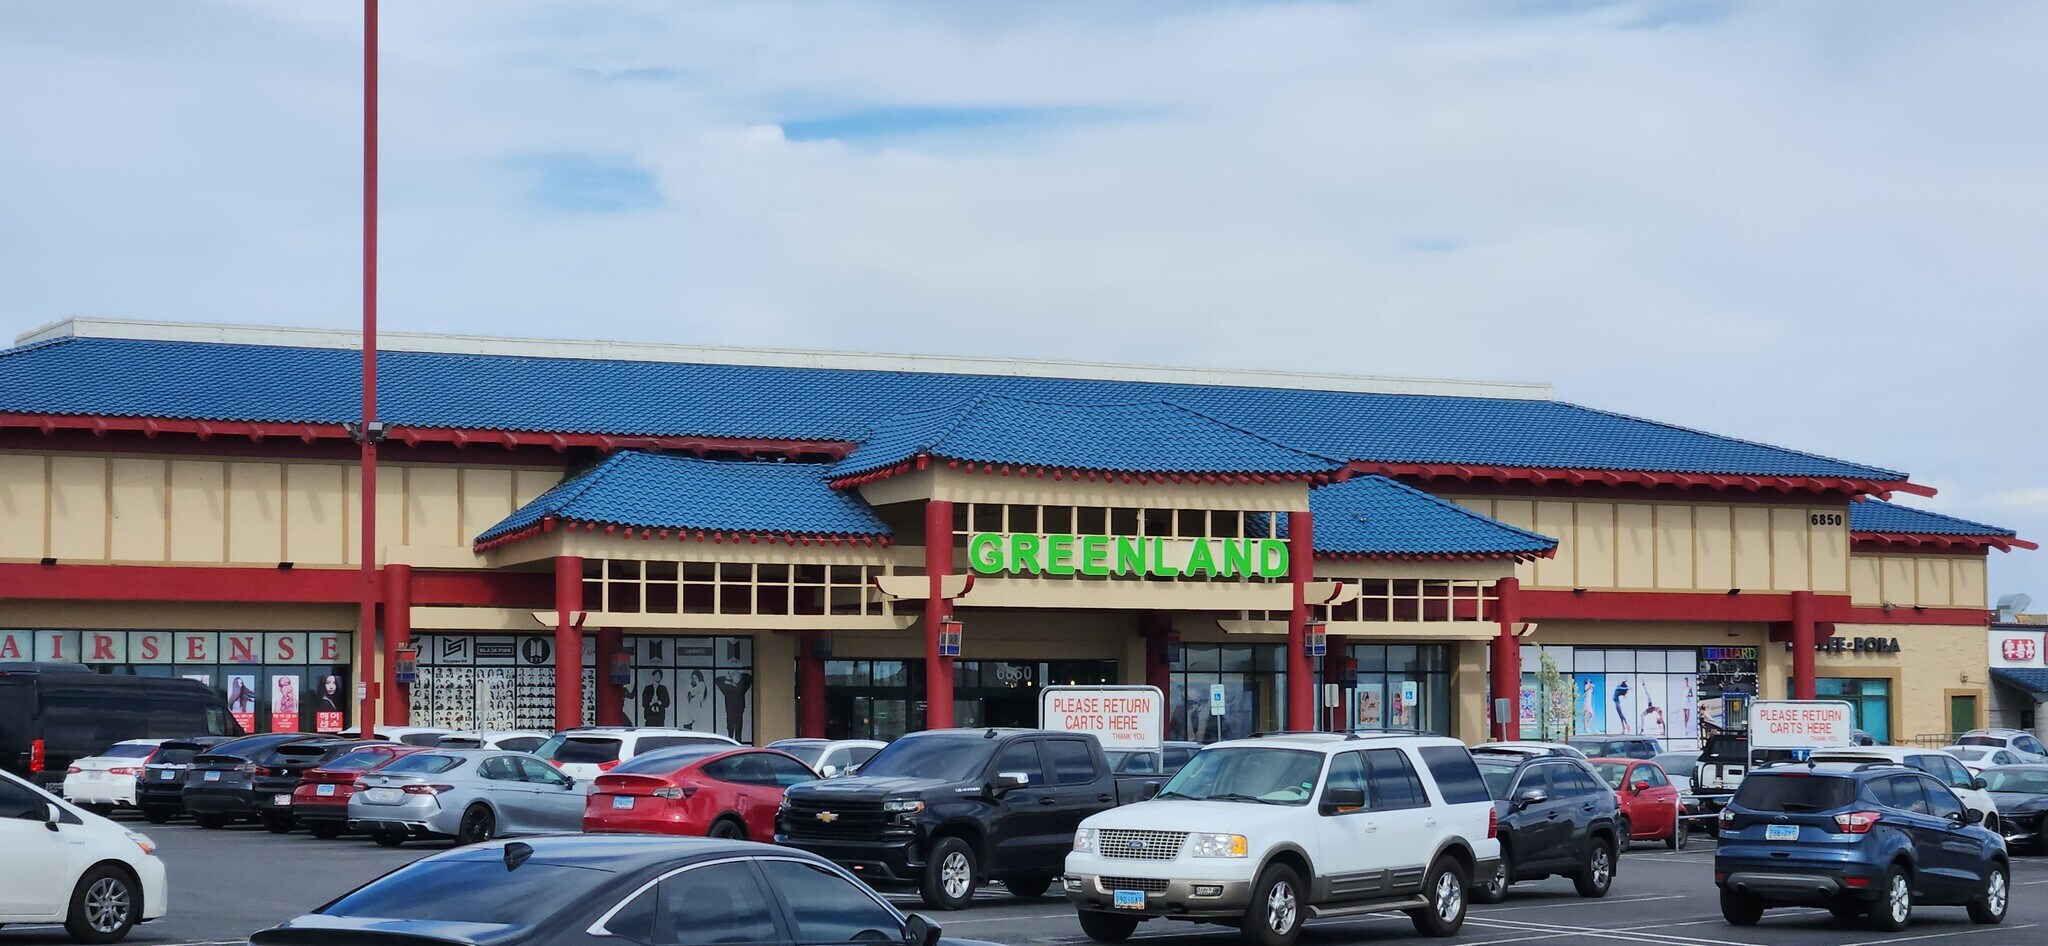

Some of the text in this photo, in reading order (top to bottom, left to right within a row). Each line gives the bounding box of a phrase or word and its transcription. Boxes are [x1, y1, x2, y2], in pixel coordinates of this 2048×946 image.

[1811, 514, 1842, 526] 6850
[968, 532, 1290, 578] GREENLAND
[1054, 698, 1150, 713] PLEASE RETURN
[1760, 709, 1842, 721] PLEASE RETURN
[1065, 715, 1138, 730] CARTS HERE
[1770, 722, 1832, 734] CARTS HERE
[1112, 732, 1145, 740] THANK YOU
